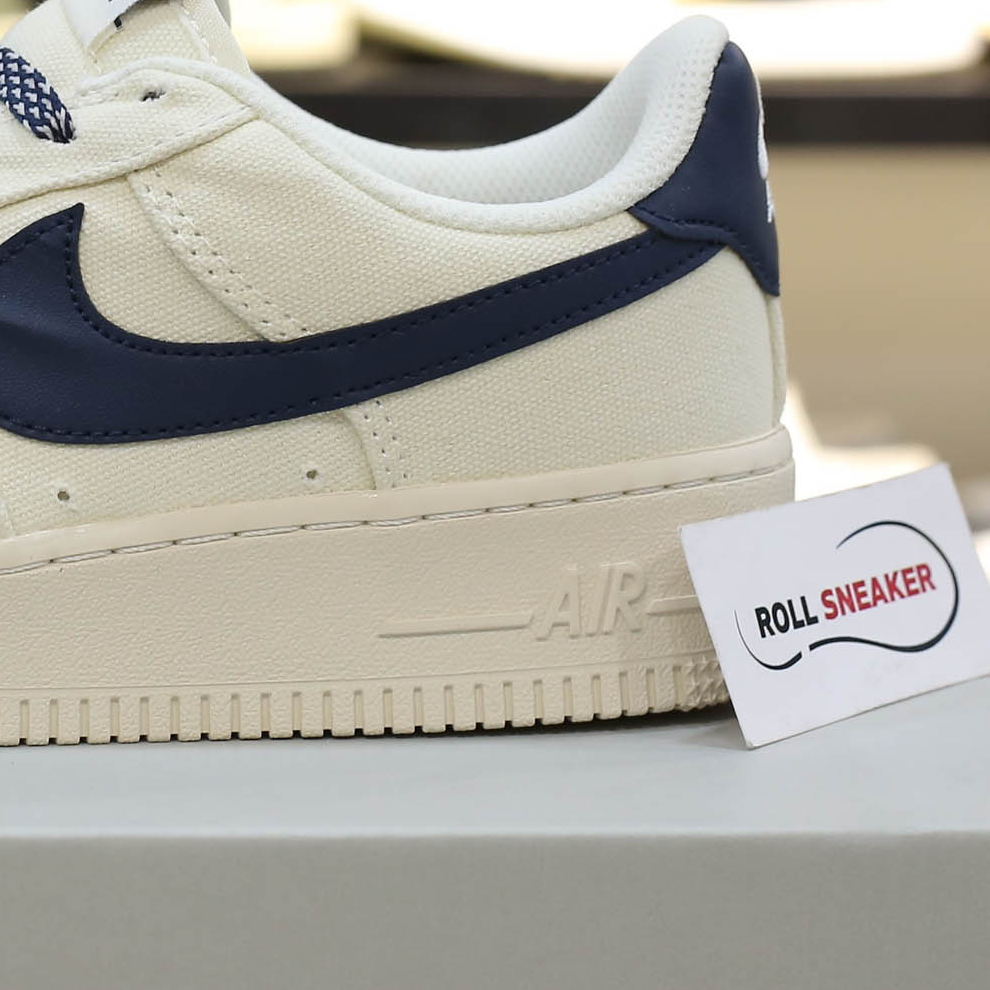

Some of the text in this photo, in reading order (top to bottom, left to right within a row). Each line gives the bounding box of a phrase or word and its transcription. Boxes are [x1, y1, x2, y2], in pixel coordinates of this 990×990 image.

[534, 562, 648, 642] AIR
[755, 563, 936, 639] ROLL SNEAKER
